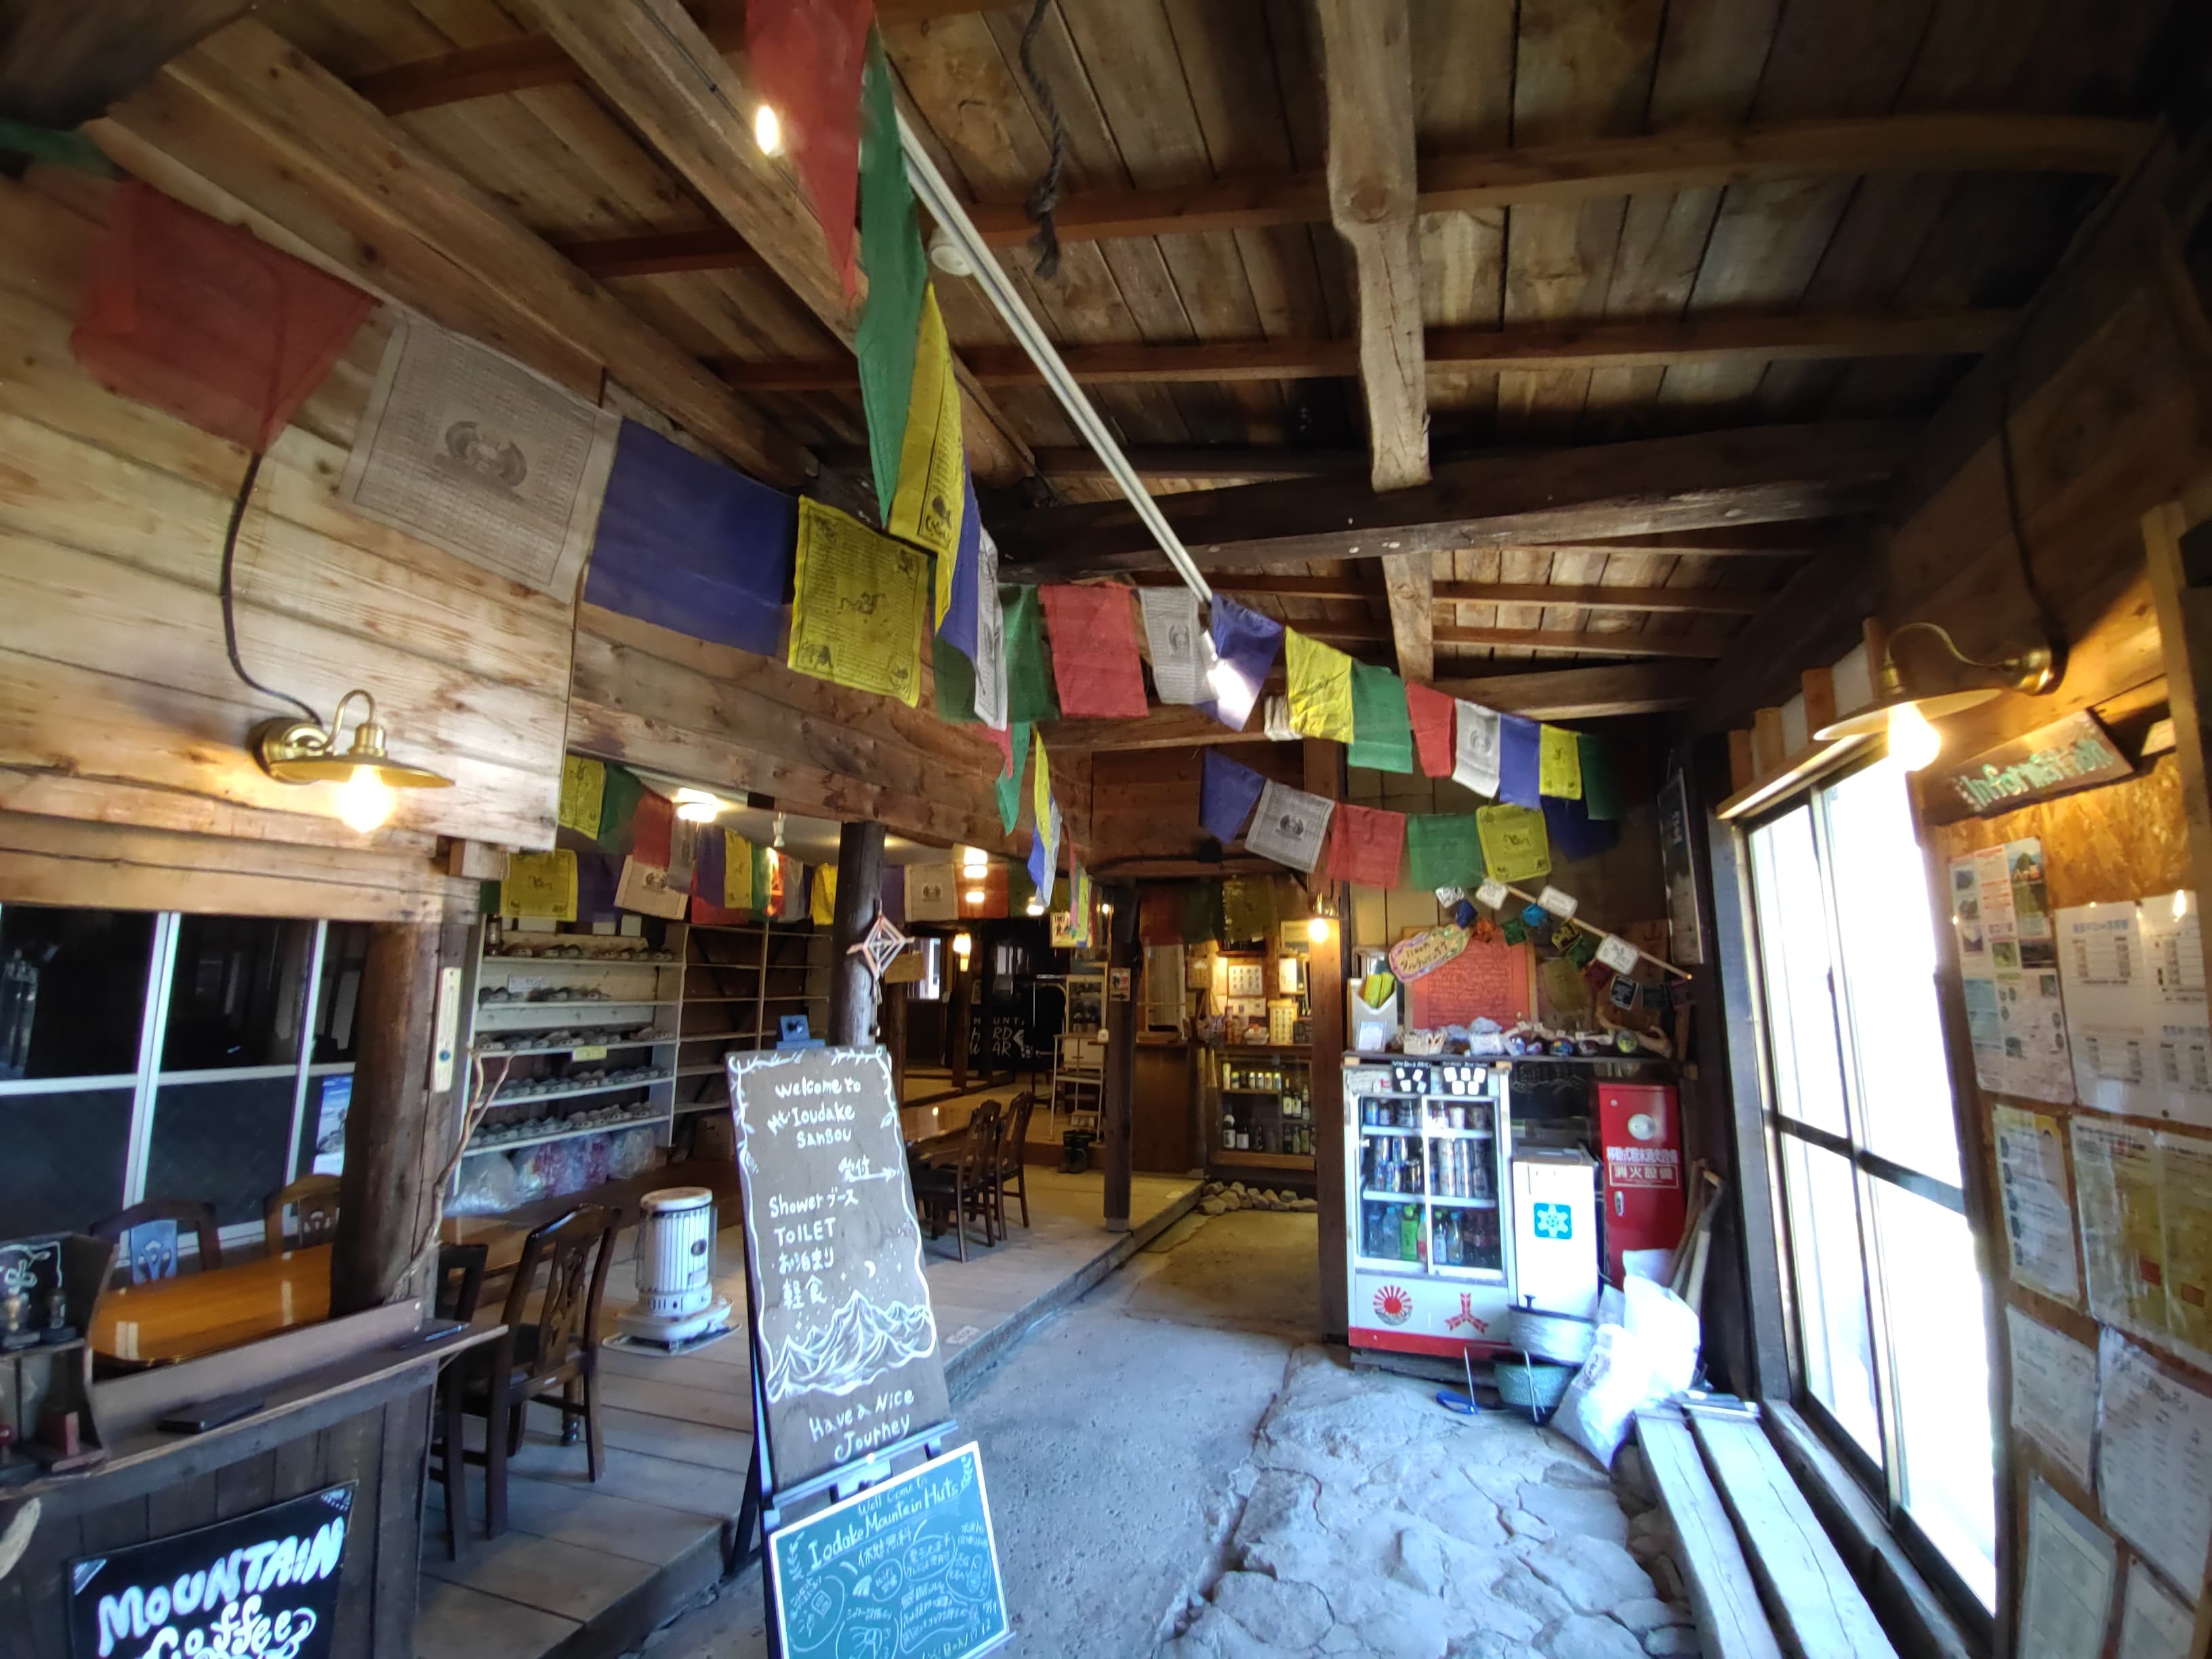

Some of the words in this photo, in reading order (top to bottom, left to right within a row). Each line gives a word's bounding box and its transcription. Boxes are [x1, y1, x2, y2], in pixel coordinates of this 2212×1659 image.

[1960, 737, 2114, 807] Information
[844, 1076, 861, 1093] to
[792, 1101, 855, 1127] Ioudake
[769, 1193, 823, 1218] Shower
[779, 1246, 834, 1275] お泊まり
[783, 1275, 827, 1310] 軽食
[808, 1409, 853, 1442] Have
[857, 1403, 872, 1420] a
[876, 1389, 914, 1413] Nice
[834, 1414, 910, 1463] Journey
[808, 1523, 864, 1570] Iodake
[865, 1500, 922, 1538] Mountain
[98, 1516, 344, 1658] MOUNTAIN
[142, 1595, 293, 1659] Coffee
